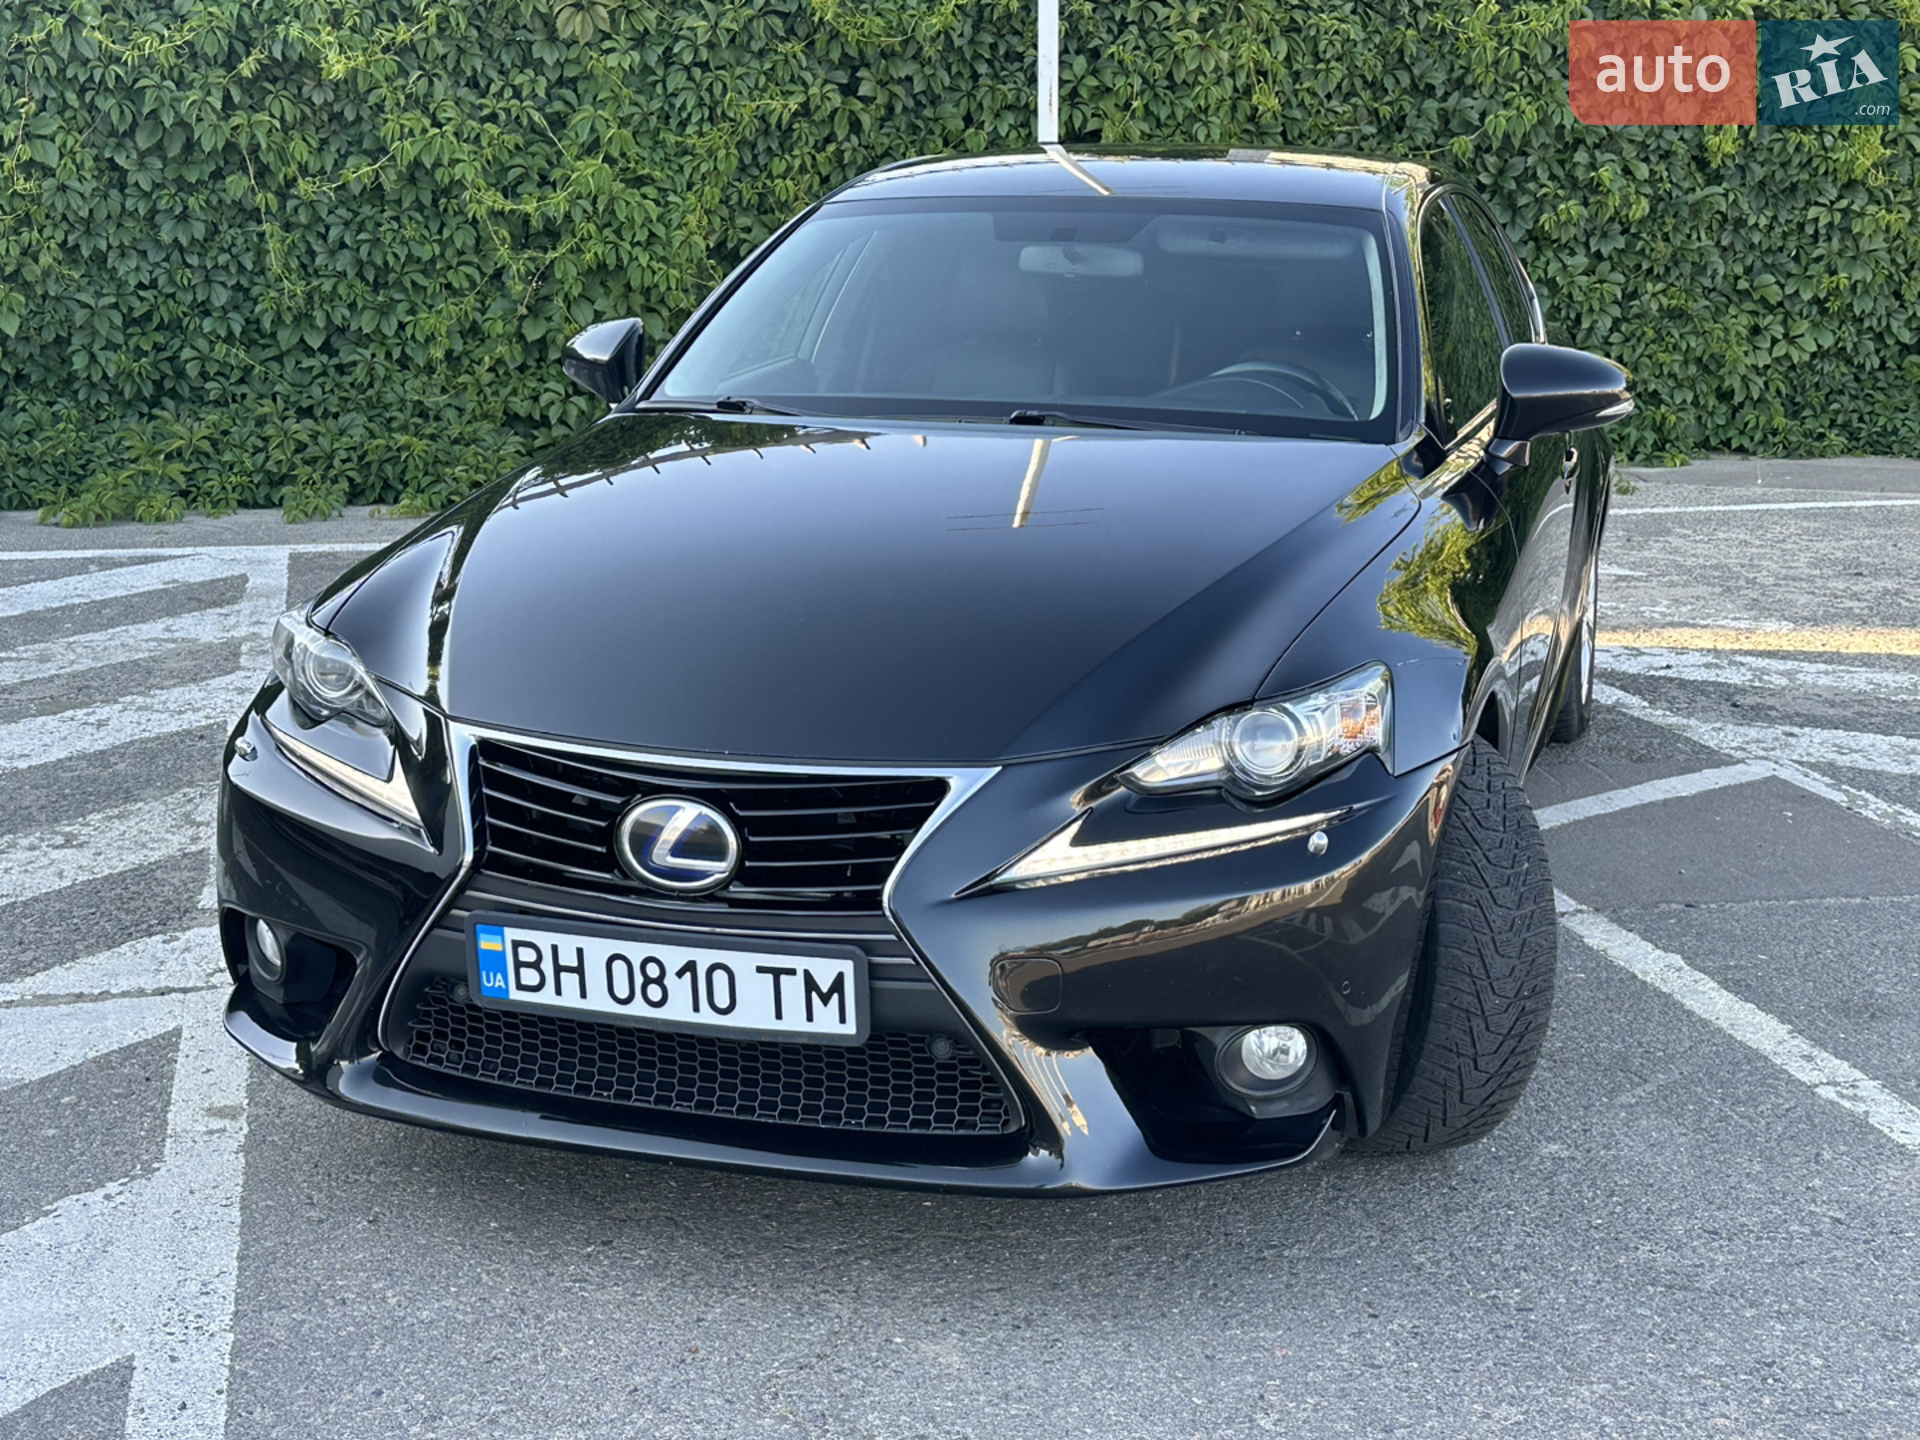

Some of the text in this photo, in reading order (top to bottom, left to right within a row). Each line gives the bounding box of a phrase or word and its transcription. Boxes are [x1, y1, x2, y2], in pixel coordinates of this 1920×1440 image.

[482, 971, 506, 990] UA
[511, 939, 847, 1025] BH 0810 TM
